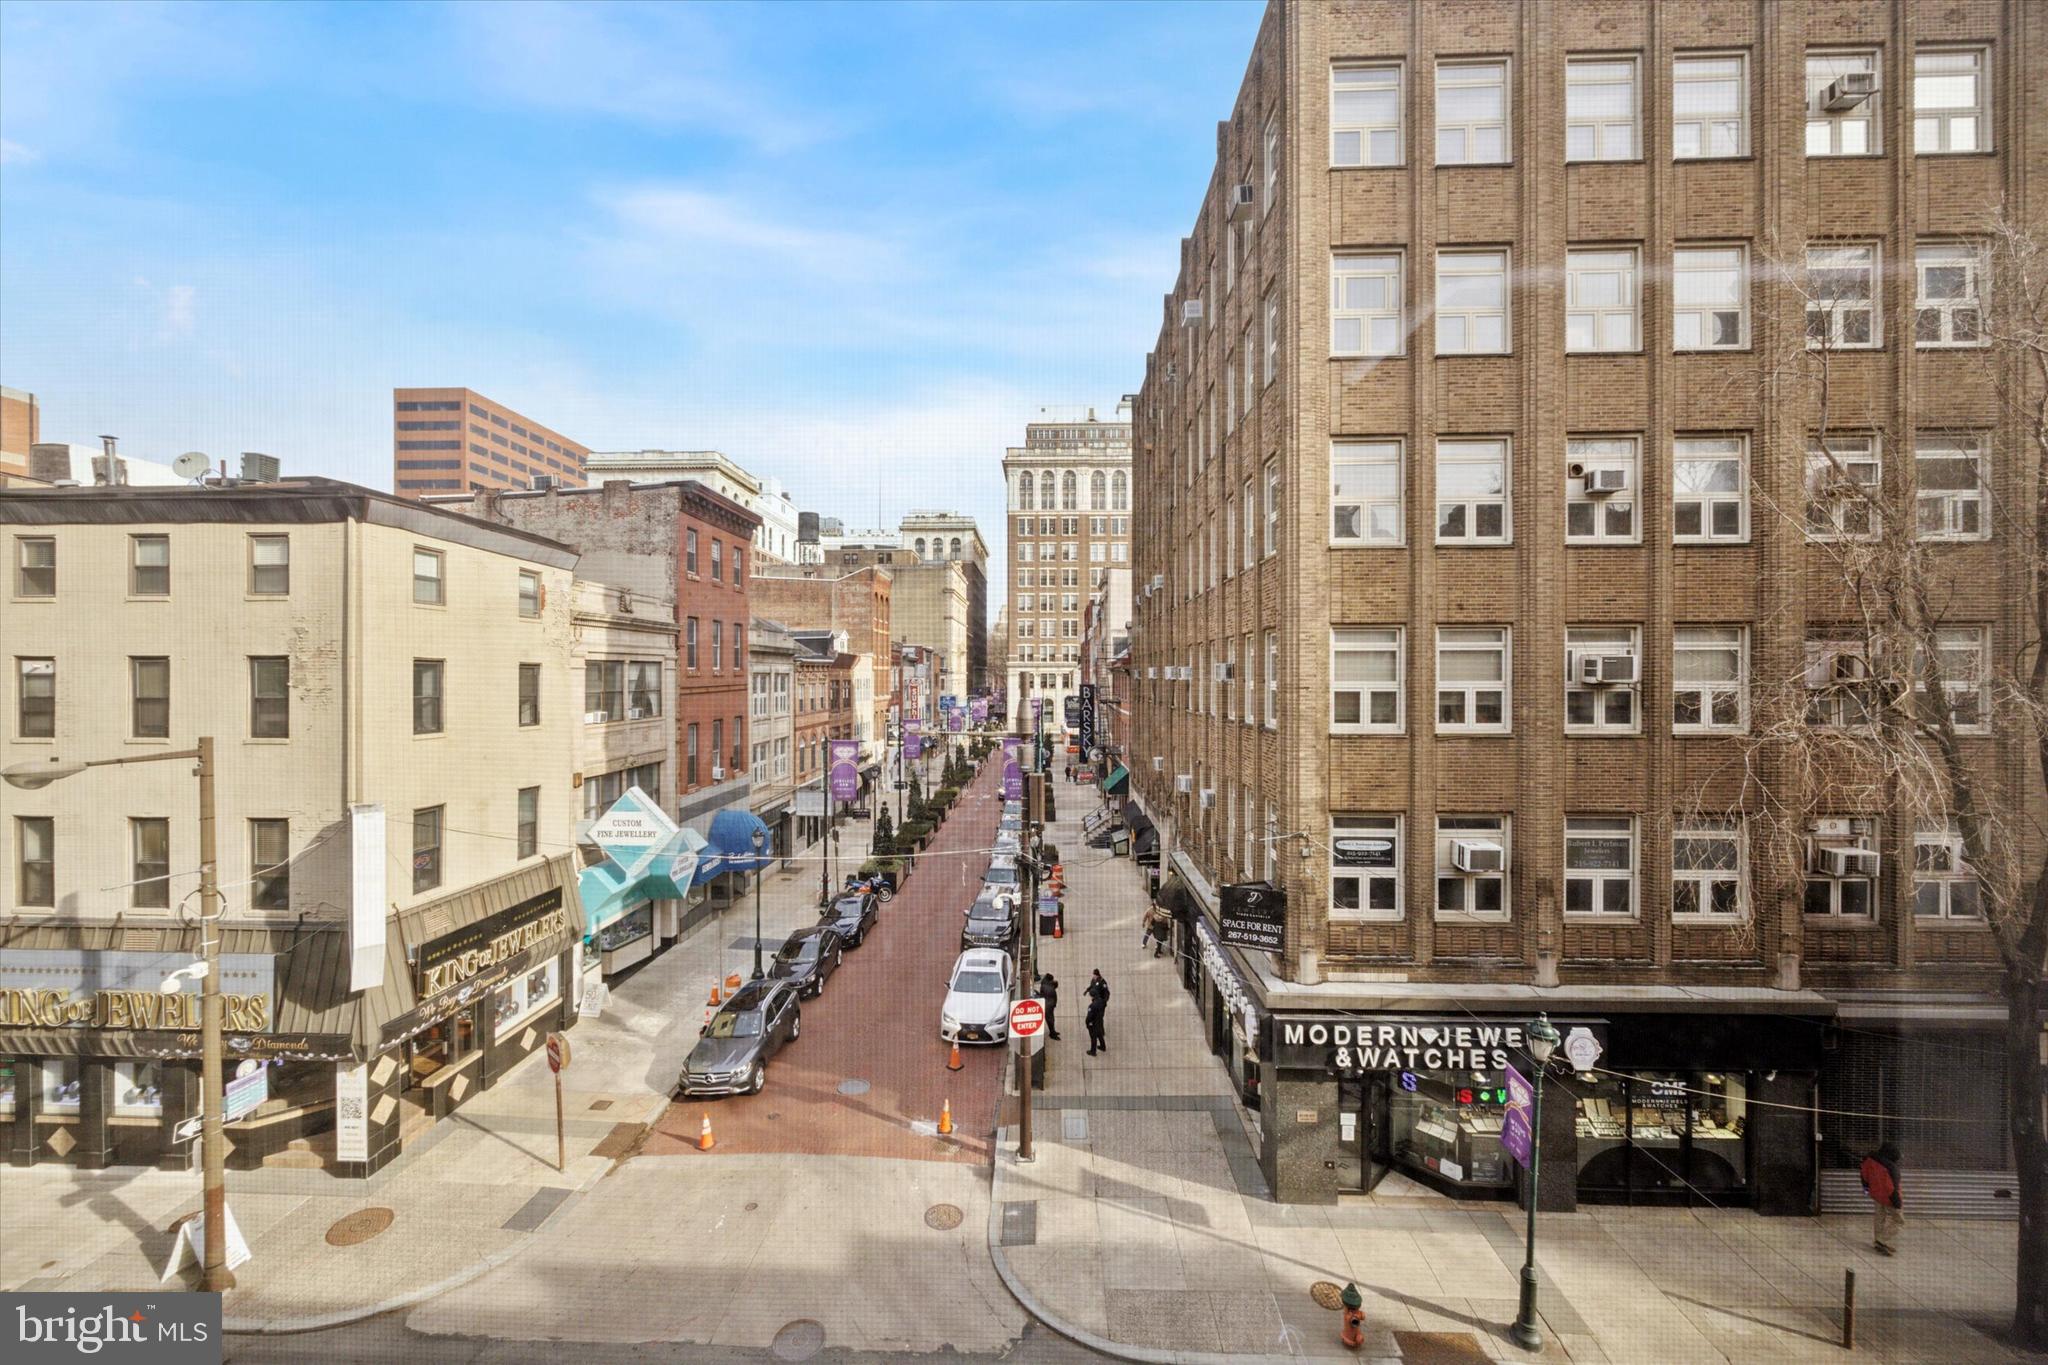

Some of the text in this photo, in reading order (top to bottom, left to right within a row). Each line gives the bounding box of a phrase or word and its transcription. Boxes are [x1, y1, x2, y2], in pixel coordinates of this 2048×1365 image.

[1082, 686, 1092, 758] BARSKY
[612, 820, 642, 828] CUSTOM
[1222, 918, 1284, 934] SPACE FOR RENT
[1227, 931, 1279, 944] 267-519-3652
[423, 949, 479, 998] KING
[490, 909, 567, 966] JEWELERS
[0, 990, 66, 1027] ING
[91, 991, 270, 1032] JEWELRS
[1027, 1006, 1040, 1014] NOT
[1017, 1021, 1037, 1029] ENTER
[1285, 1024, 1419, 1048] MODERN
[252, 1037, 310, 1051] Diamonds
